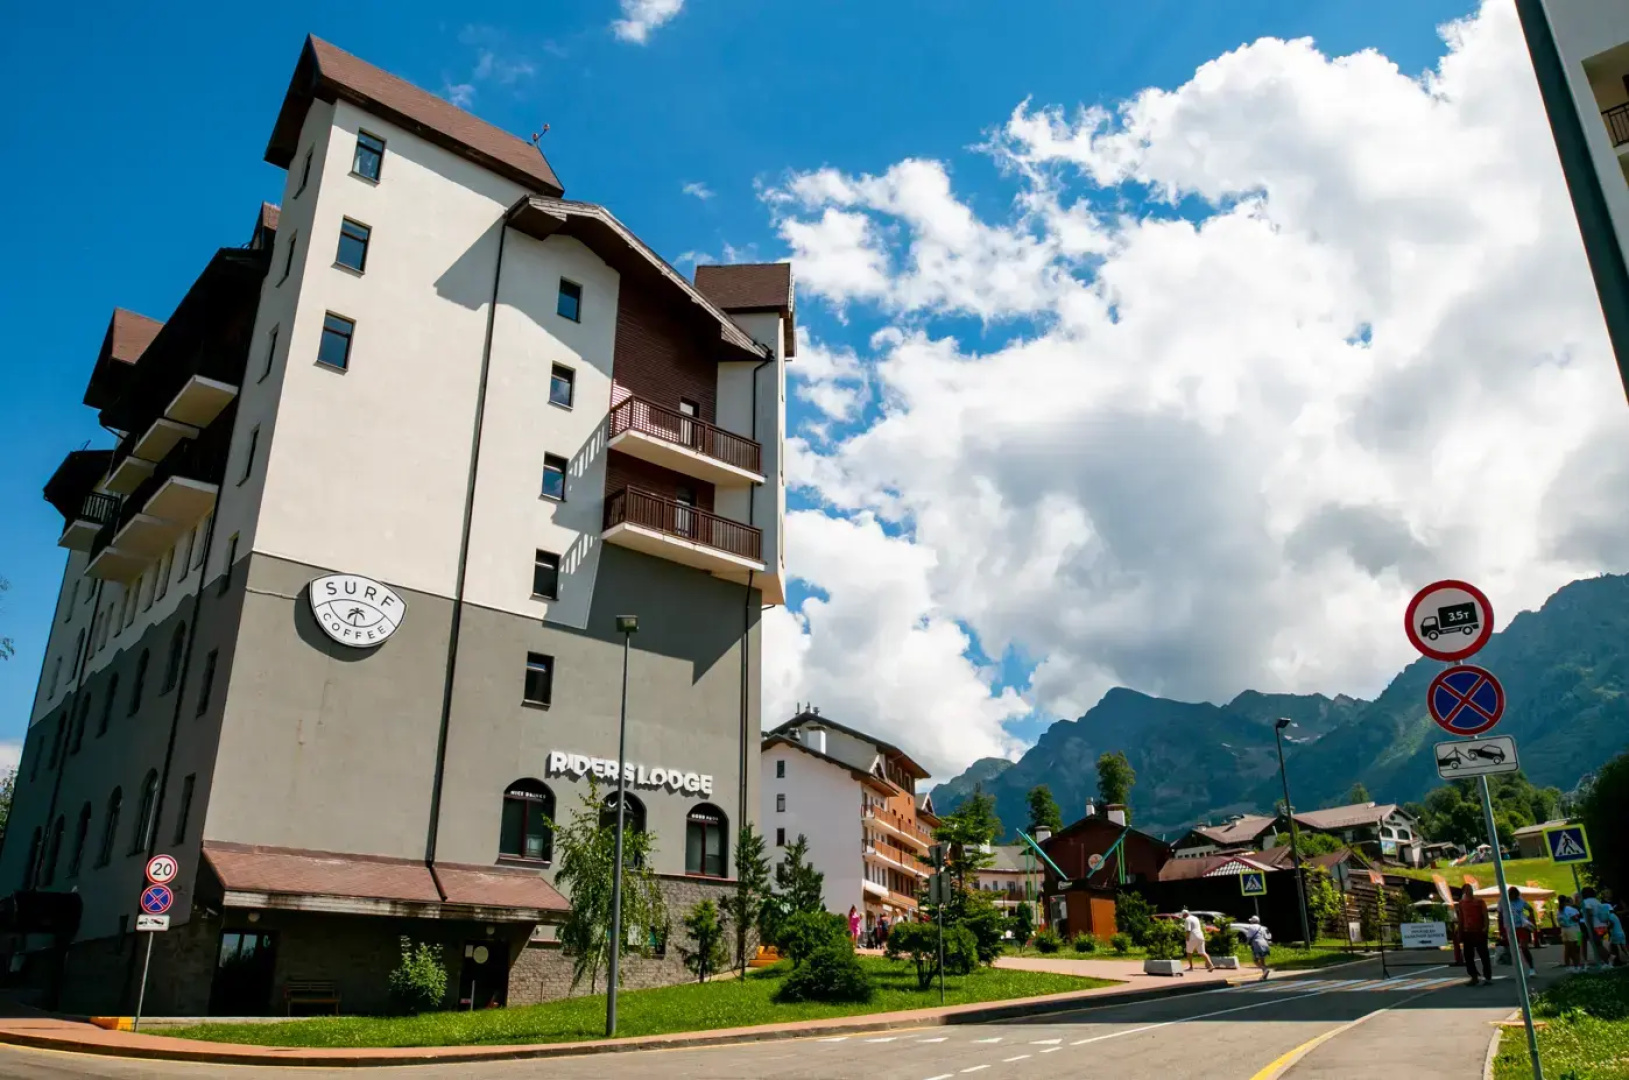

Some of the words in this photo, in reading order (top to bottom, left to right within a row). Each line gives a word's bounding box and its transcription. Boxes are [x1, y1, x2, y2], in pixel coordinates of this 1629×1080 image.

[326, 581, 395, 606] SURF
[323, 612, 386, 639] COFFEE
[550, 751, 635, 782] RIDERS
[637, 764, 713, 794] LODGE
[153, 862, 172, 876] 20
